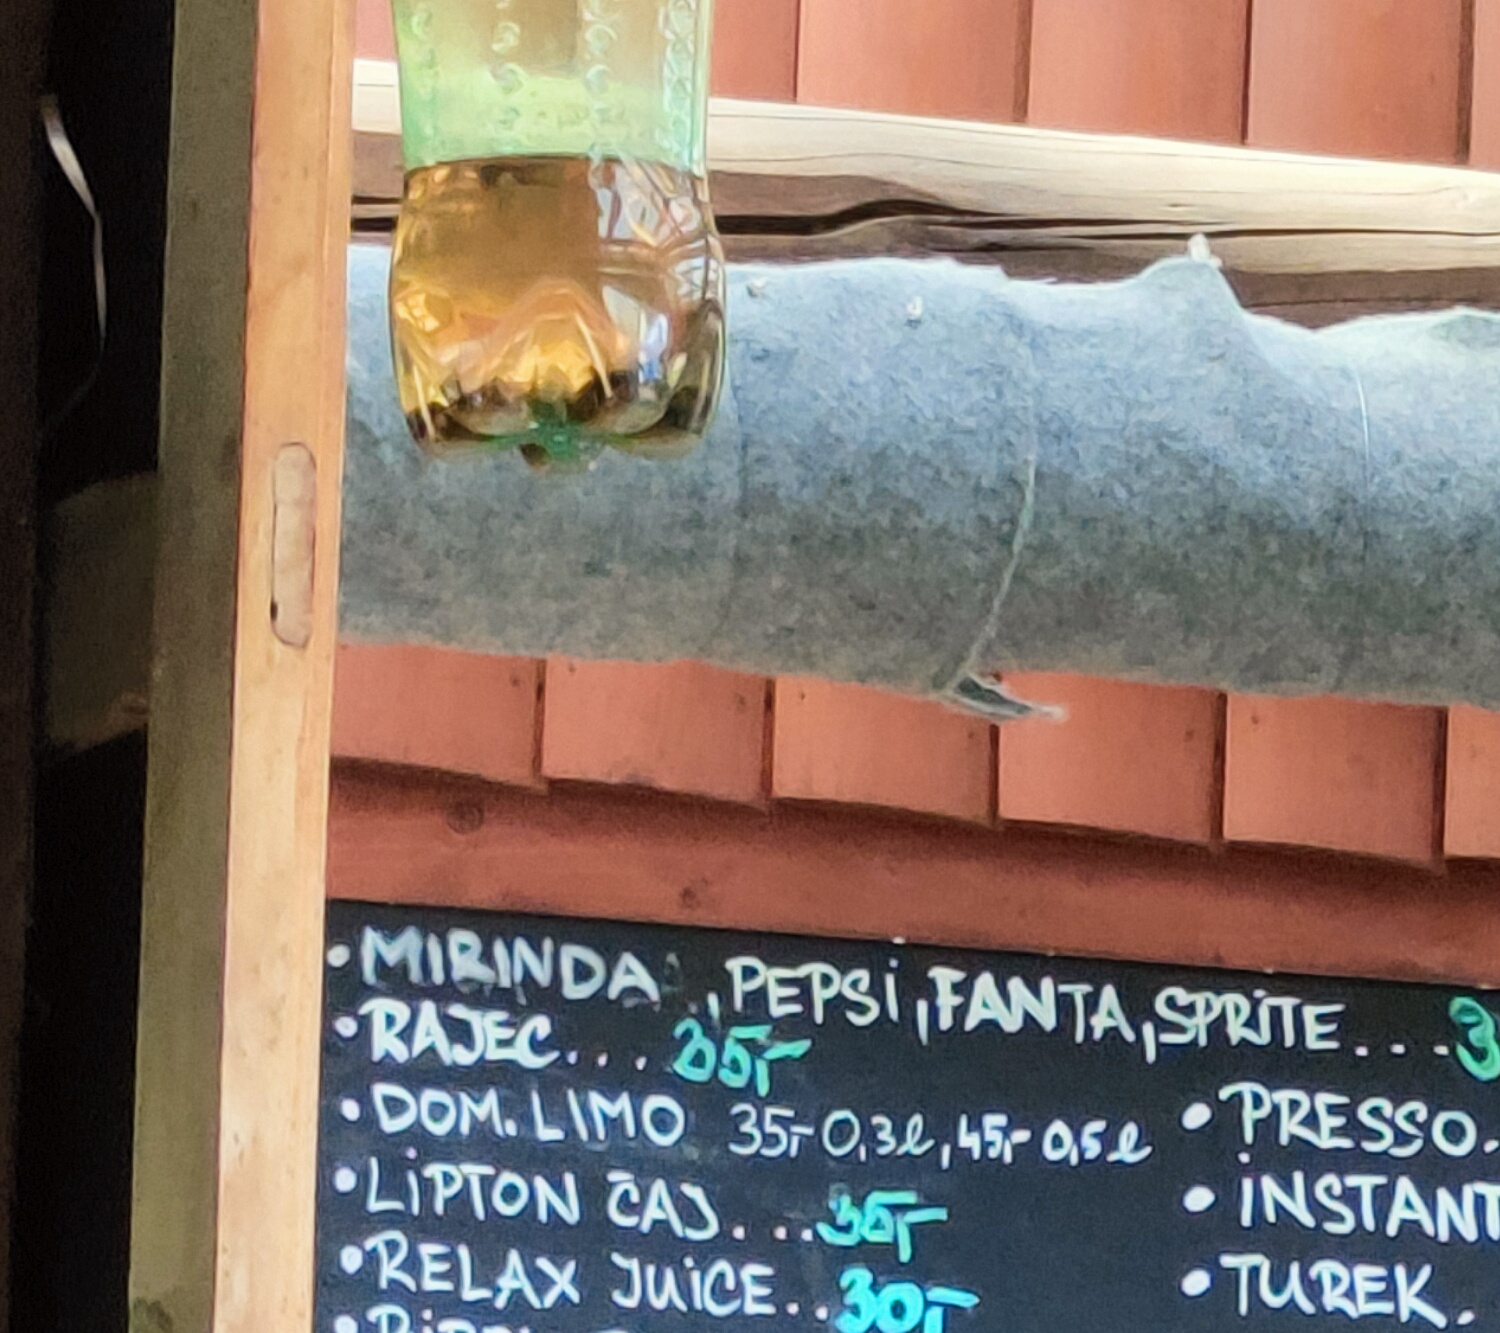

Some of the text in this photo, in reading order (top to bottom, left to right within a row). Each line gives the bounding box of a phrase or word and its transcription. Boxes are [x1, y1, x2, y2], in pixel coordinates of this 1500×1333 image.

[359, 925, 660, 1002] MIRINDA
[362, 1229, 581, 1310] RELAX
[1218, 1253, 1448, 1329] TUREK
